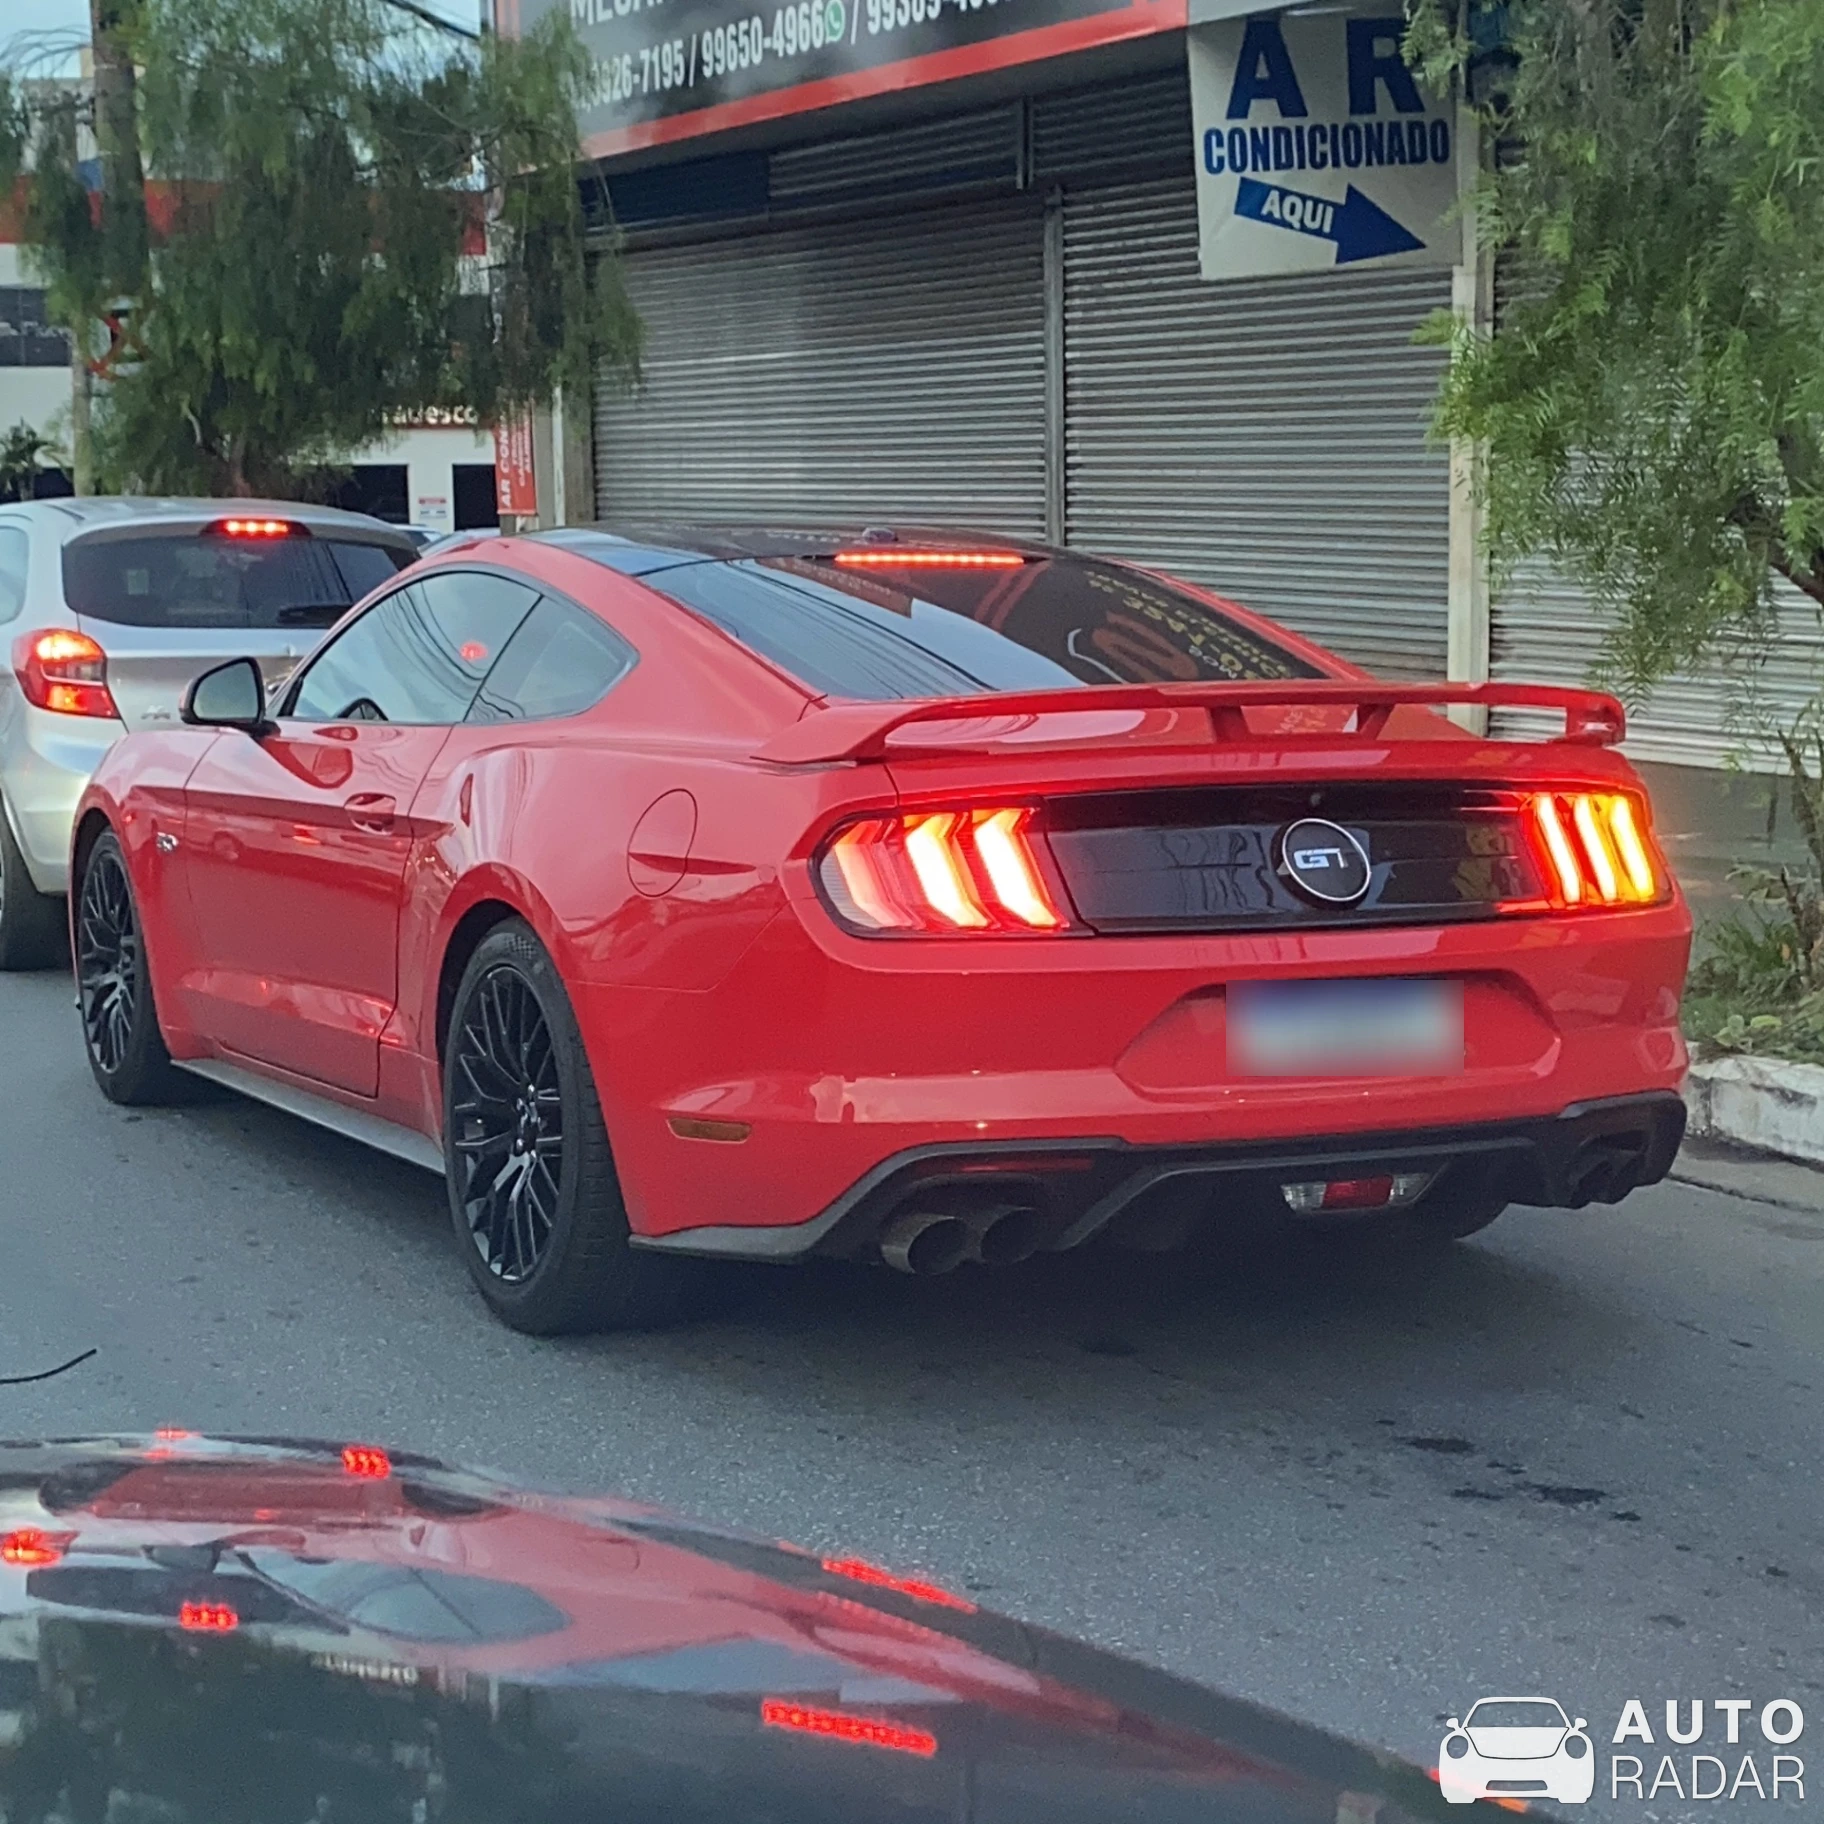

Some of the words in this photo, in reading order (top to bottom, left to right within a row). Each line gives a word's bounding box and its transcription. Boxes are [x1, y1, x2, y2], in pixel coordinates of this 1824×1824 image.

[701, 0, 824, 79] 99650-4966
[1203, 119, 1450, 175] CONDICIONADO
[1260, 189, 1335, 234] AQUI
